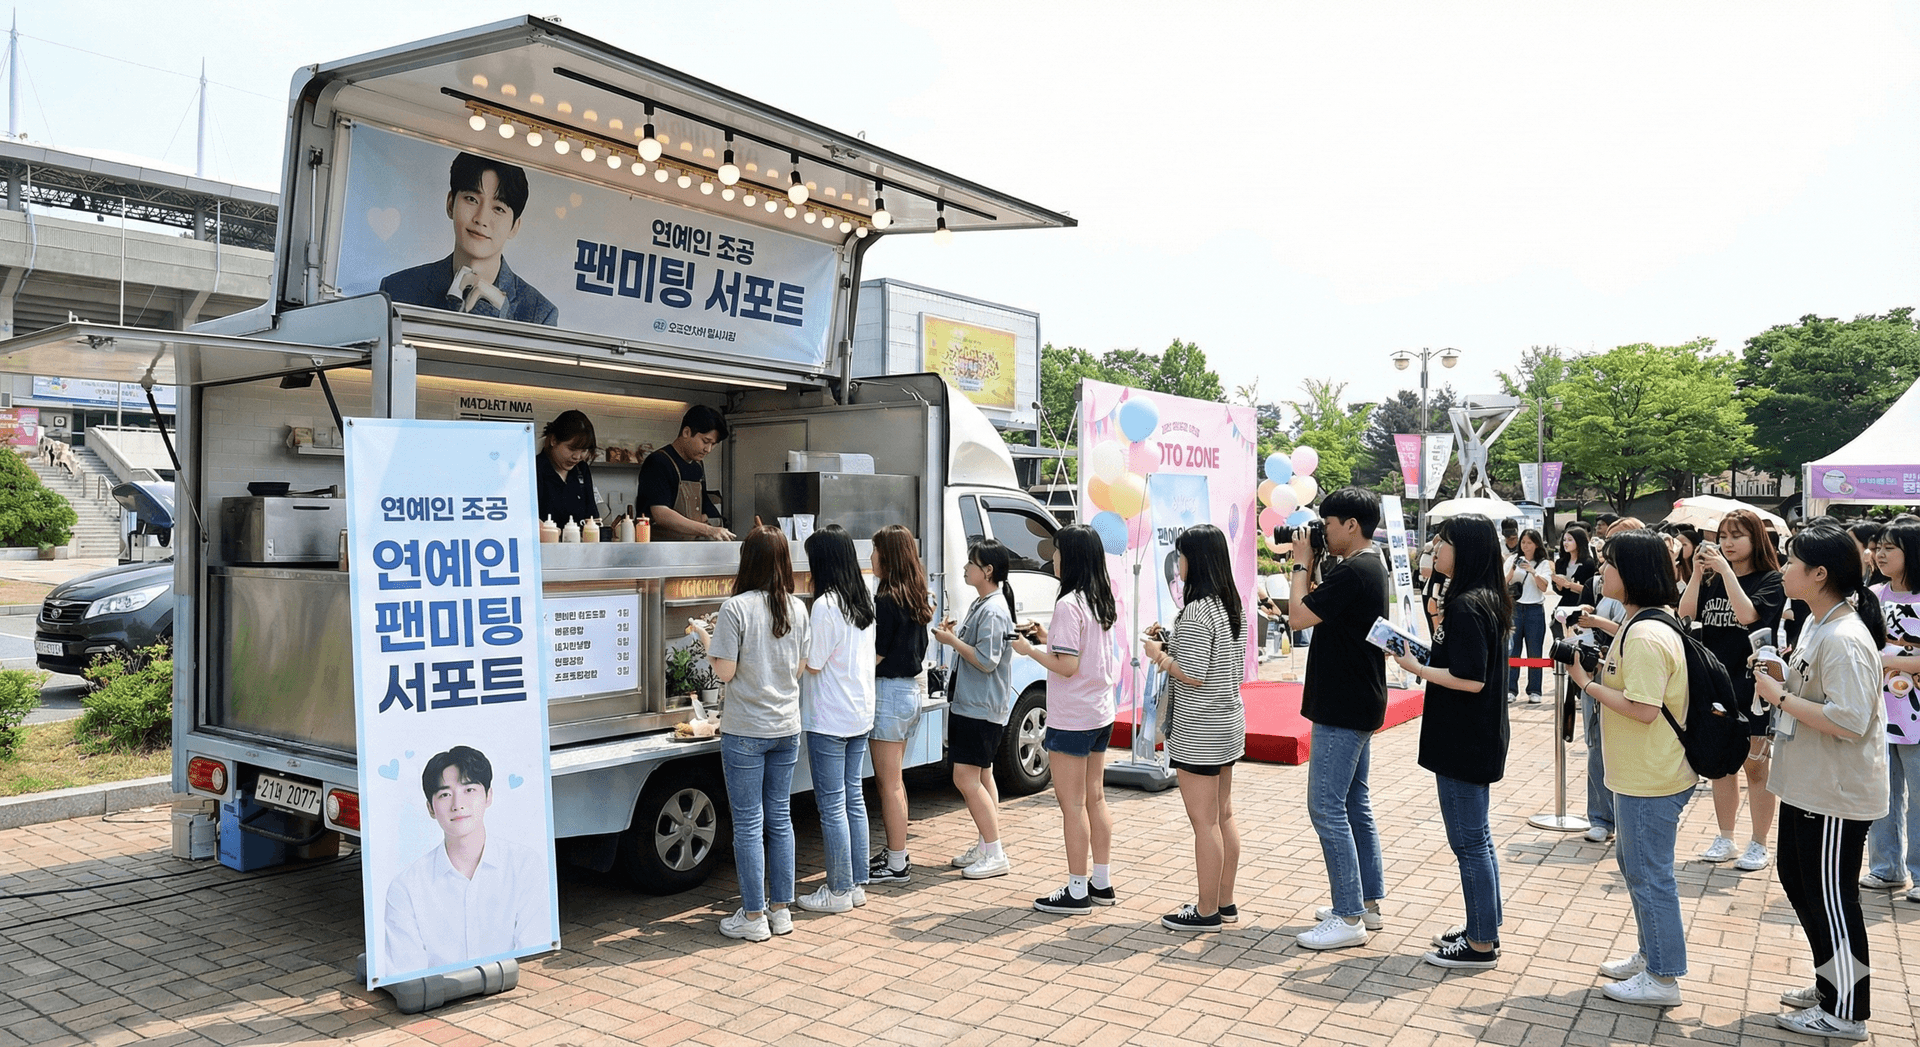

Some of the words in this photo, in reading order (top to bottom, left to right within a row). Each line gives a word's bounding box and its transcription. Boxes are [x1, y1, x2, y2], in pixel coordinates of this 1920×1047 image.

[652, 219, 712, 257] 연예인
[716, 234, 755, 265] 조공
[574, 239, 695, 309] 팬미팅
[704, 268, 805, 327] 서포트
[1157, 441, 1183, 467] OTO
[1185, 445, 1220, 469] ZONE
[380, 496, 455, 522] 연예인
[461, 496, 509, 521] 조공
[372, 537, 521, 591] 연예인
[375, 596, 523, 653] 팬미팅
[378, 656, 527, 714] 서포트
[286, 784, 317, 809] 2077
